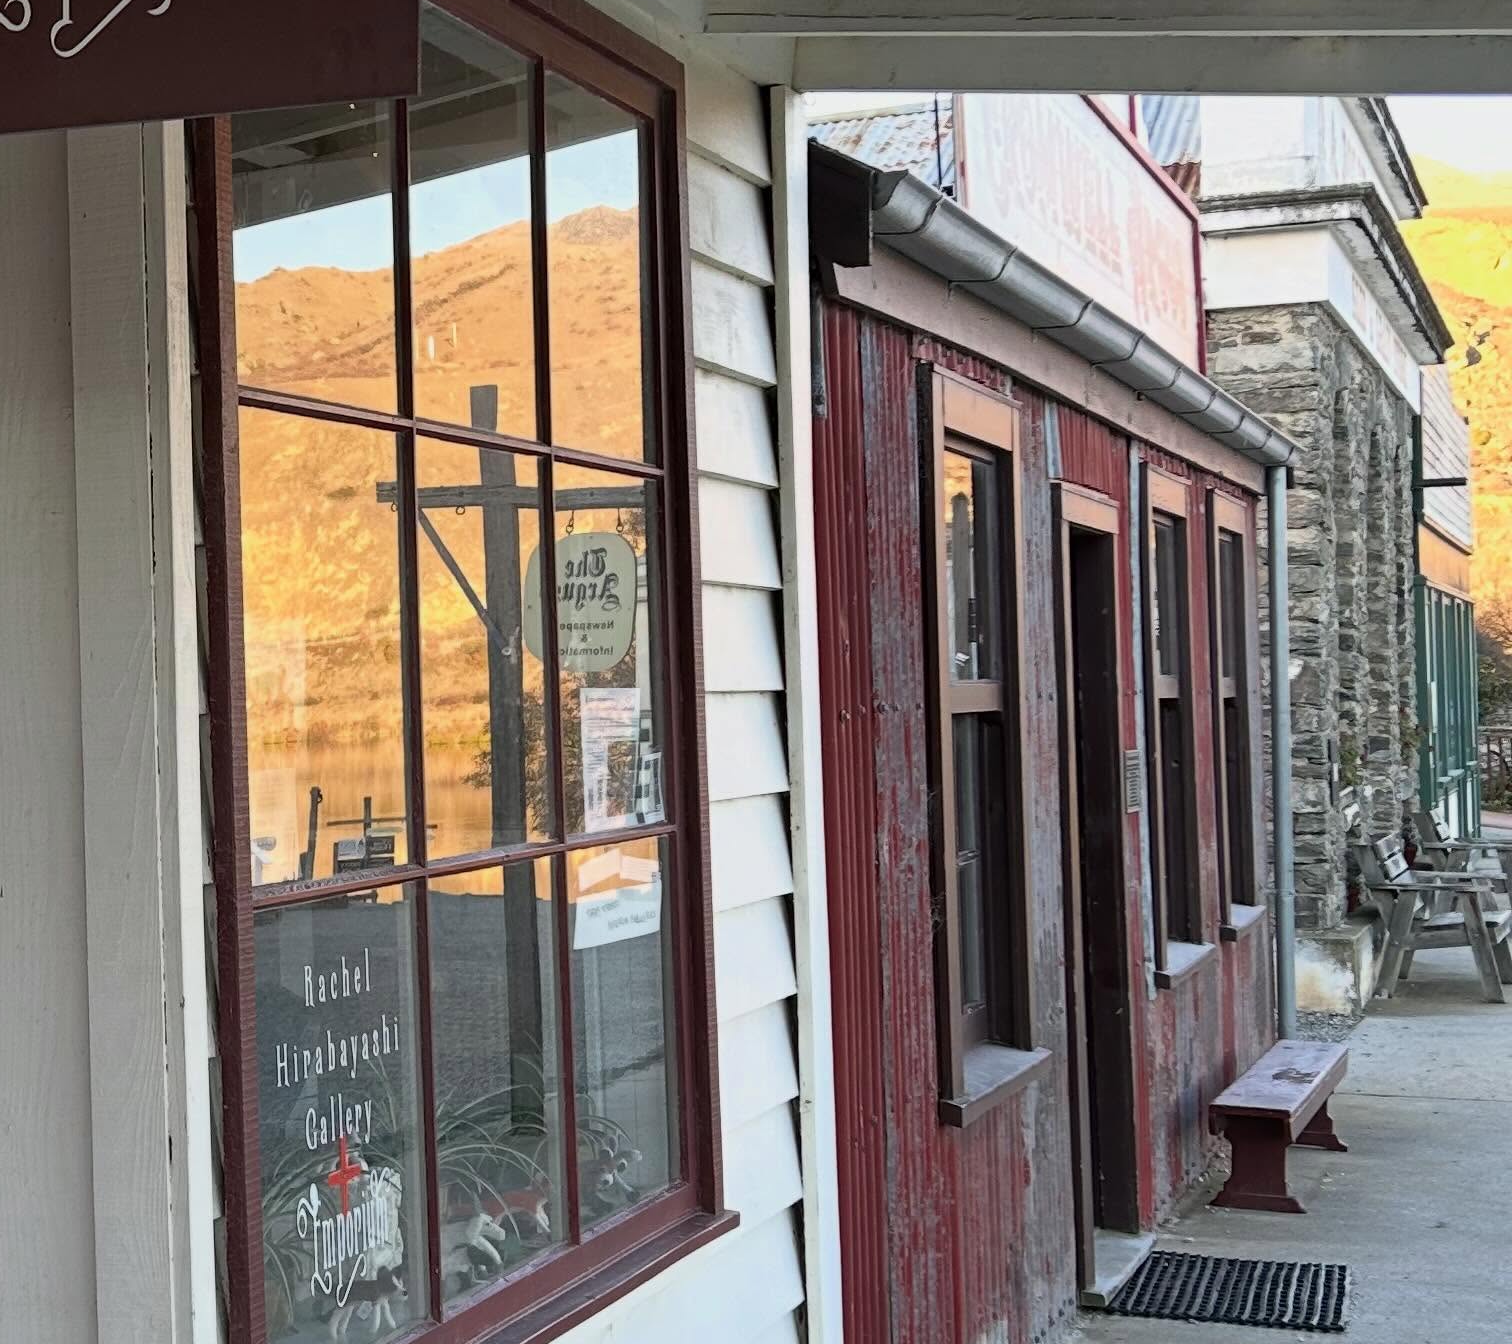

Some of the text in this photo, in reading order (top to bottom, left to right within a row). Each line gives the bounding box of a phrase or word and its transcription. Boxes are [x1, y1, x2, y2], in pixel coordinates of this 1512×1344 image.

[303, 947, 371, 1008] Rachel
[275, 1014, 400, 1088] Hirabayashi
[305, 1093, 373, 1151] Gallery
[296, 1166, 392, 1308] Emporium
